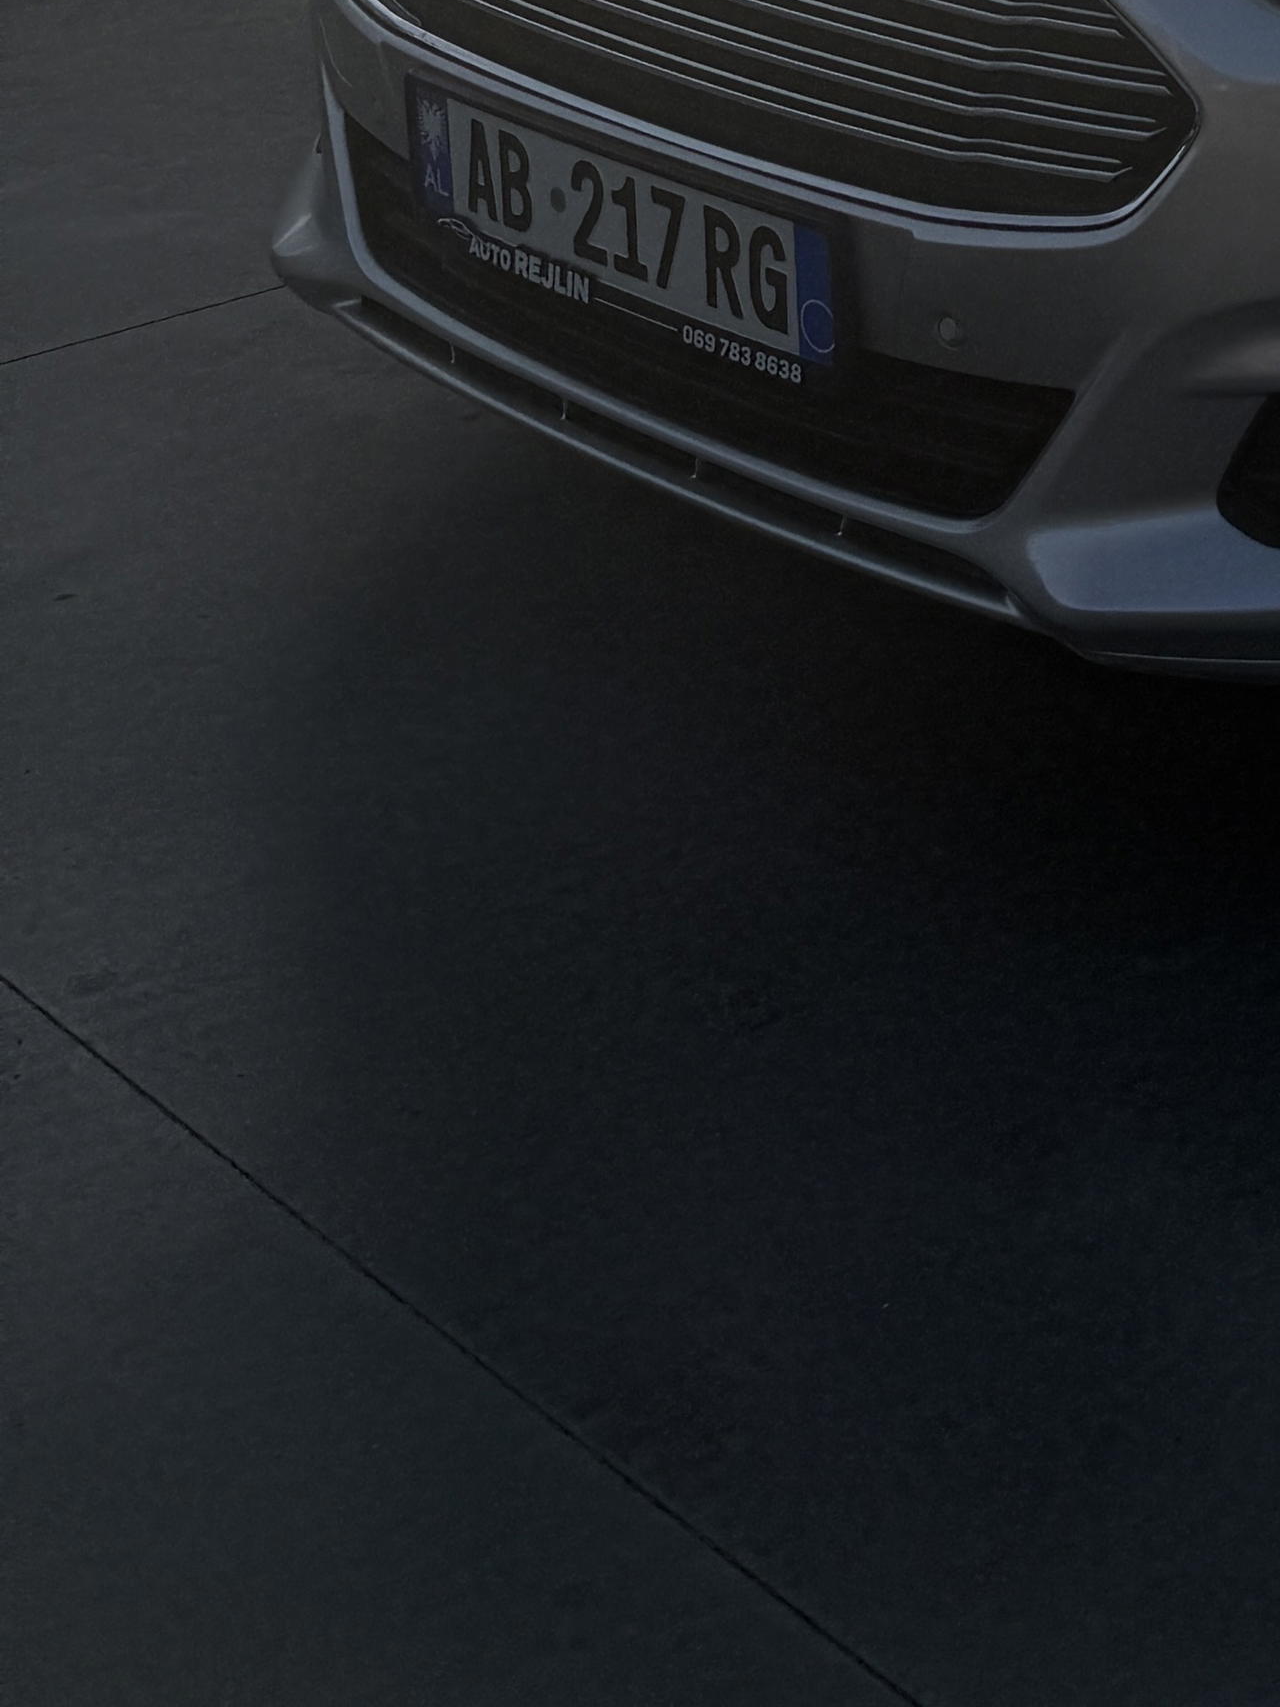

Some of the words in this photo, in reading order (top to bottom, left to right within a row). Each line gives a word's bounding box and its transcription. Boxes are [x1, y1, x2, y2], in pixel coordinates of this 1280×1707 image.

[423, 163, 449, 197] AL
[468, 118, 533, 233] AB
[570, 159, 686, 291] 217
[702, 204, 789, 336] RG
[469, 237, 511, 272] AUTO
[514, 249, 589, 304] REJLIN
[683, 325, 716, 353] 069
[718, 338, 751, 366] 783
[754, 351, 802, 384] 8638
